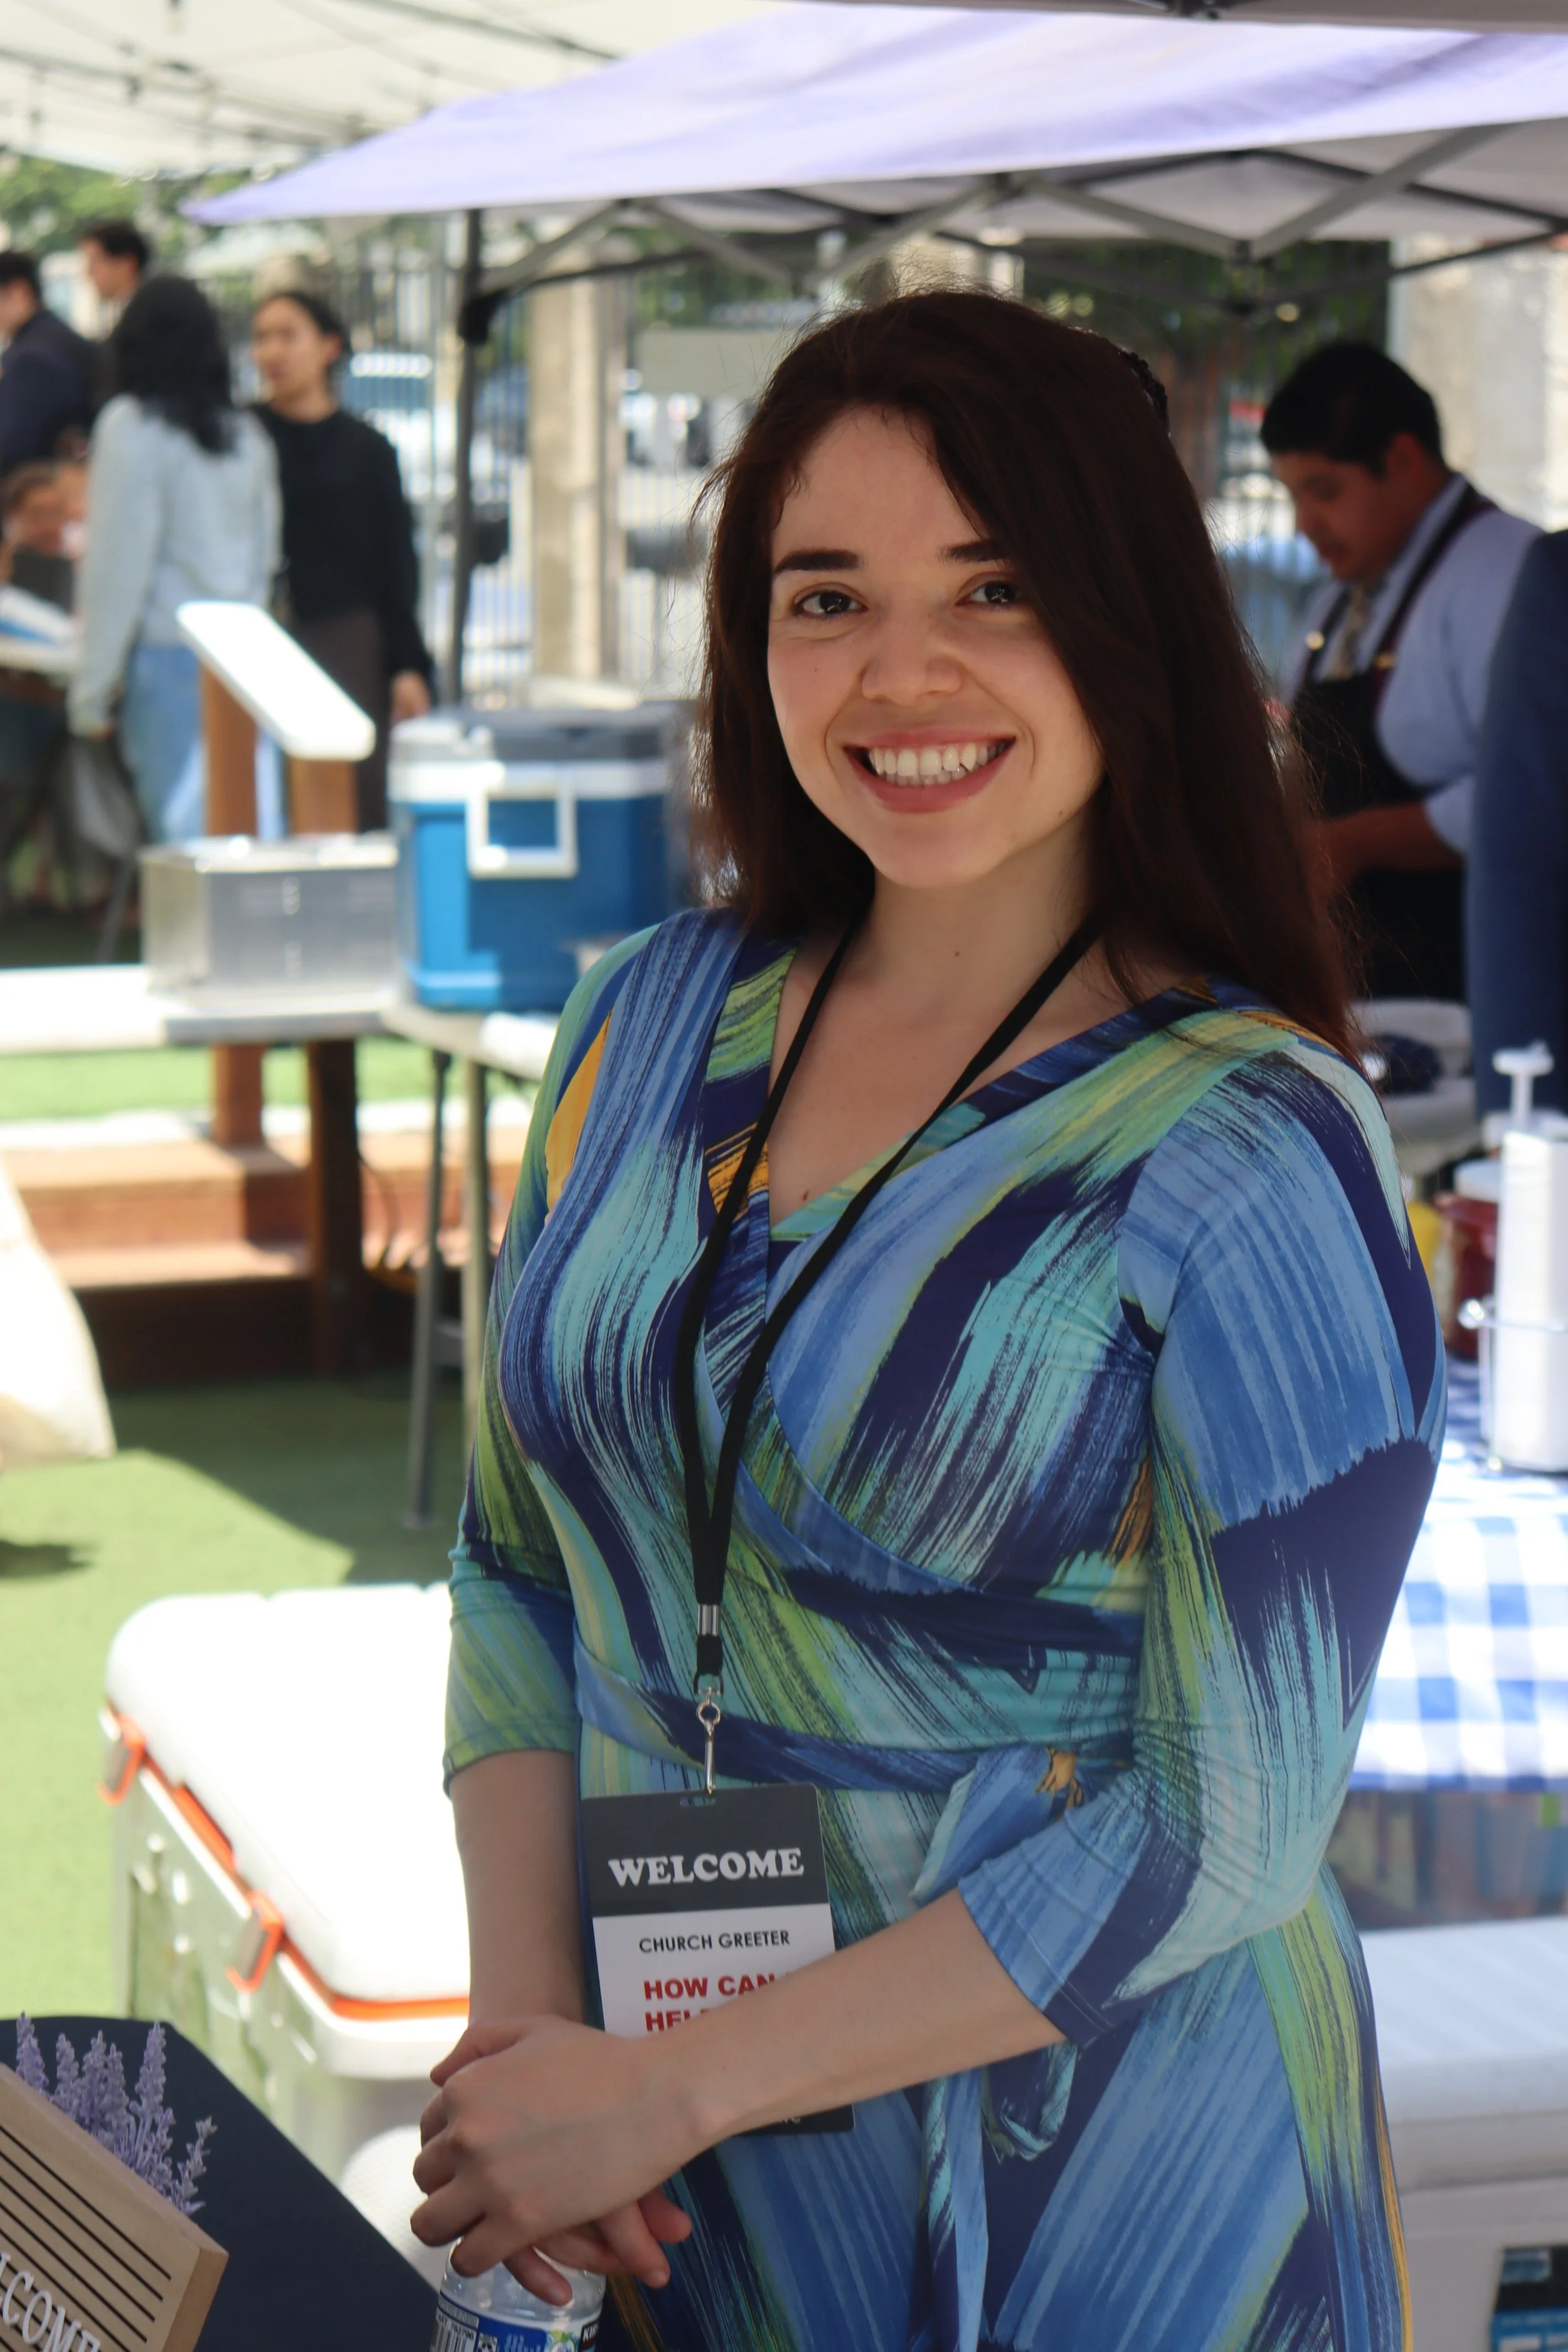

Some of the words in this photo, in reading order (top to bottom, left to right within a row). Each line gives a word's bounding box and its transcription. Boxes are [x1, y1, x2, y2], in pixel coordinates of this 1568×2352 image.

[608, 1848, 804, 1887] WELCOME
[639, 1934, 712, 1952] CHURCH
[718, 1930, 790, 1948] GREETER
[644, 1977, 708, 2001] HOW
